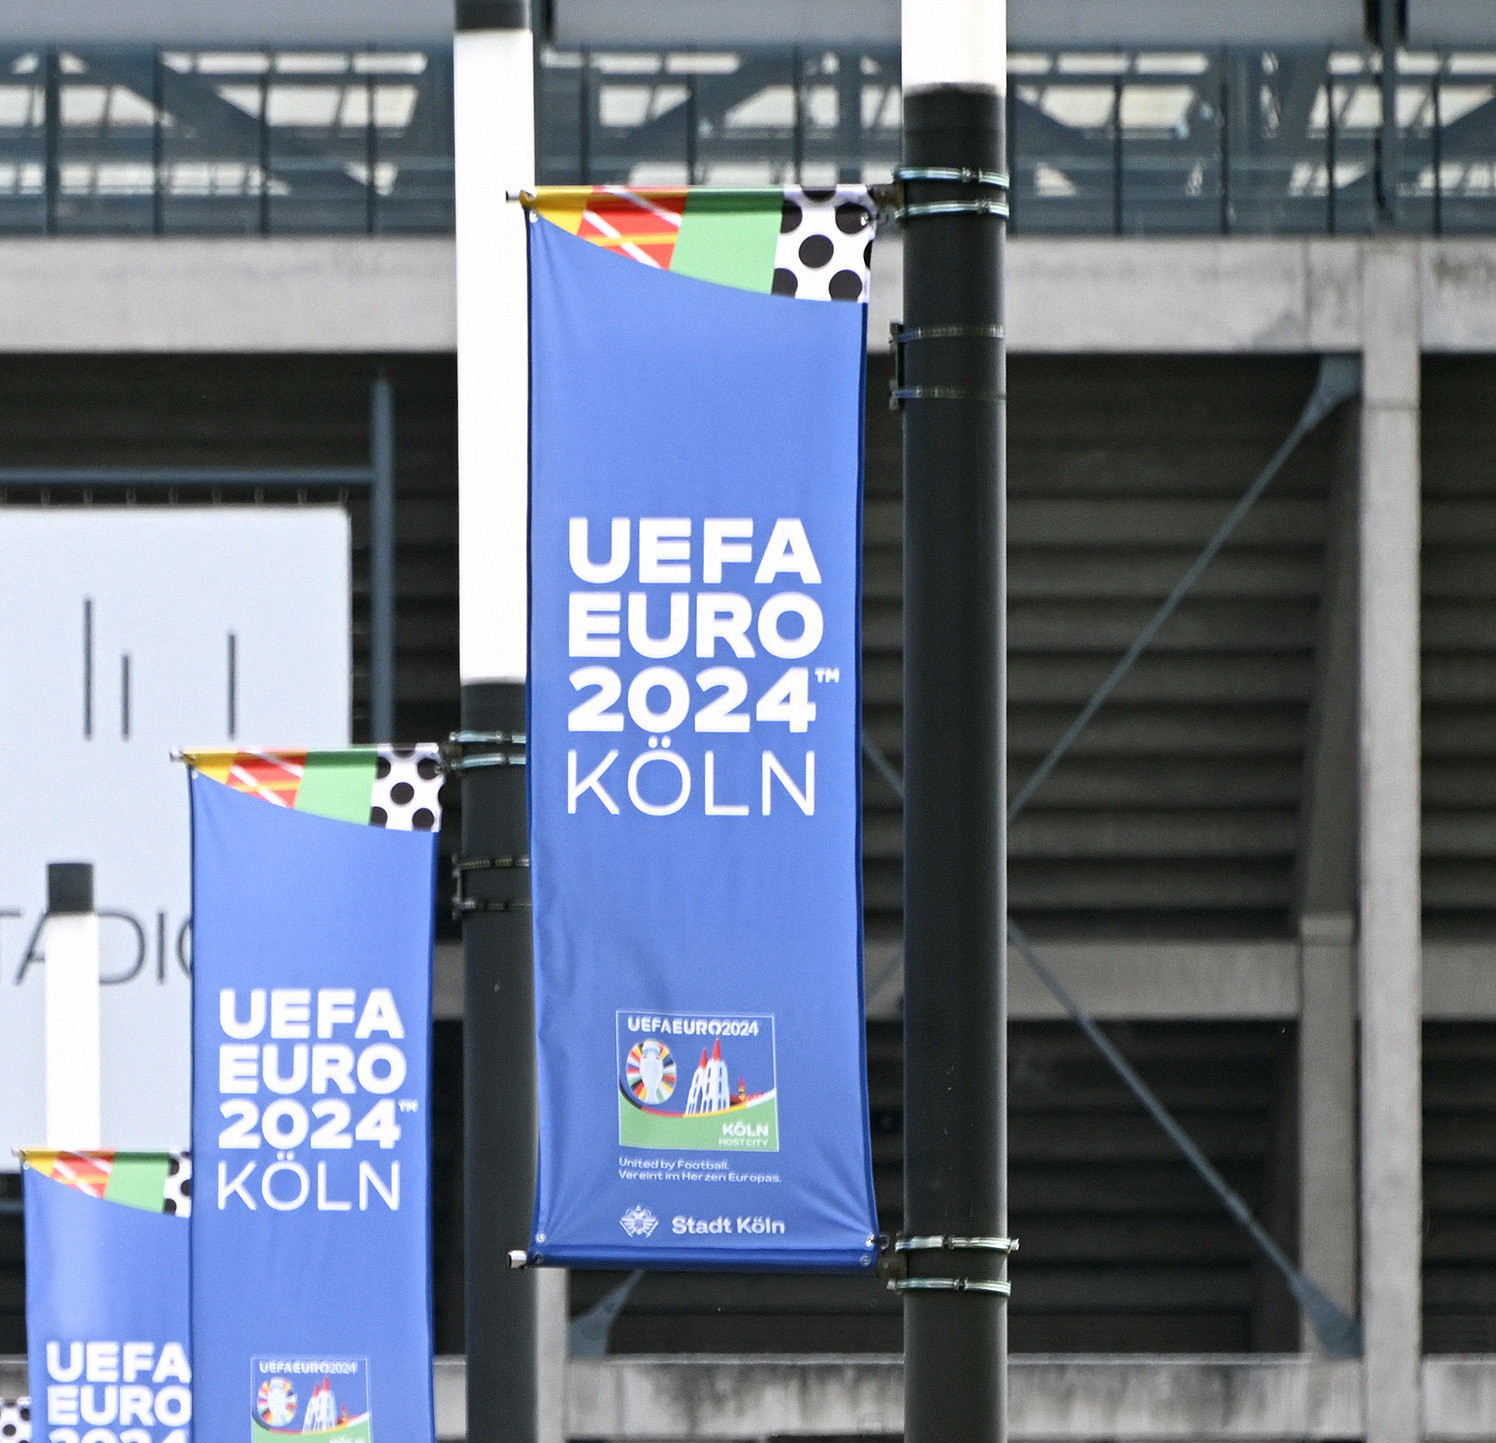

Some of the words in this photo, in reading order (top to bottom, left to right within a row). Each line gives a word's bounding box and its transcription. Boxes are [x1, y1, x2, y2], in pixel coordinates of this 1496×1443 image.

[568, 516, 821, 586] UEFA
[568, 591, 824, 660] EURO
[566, 735, 816, 817] KÖLN
[220, 988, 405, 1040] UEFA
[219, 1044, 406, 1094] EURO
[722, 1121, 769, 1137] KÖLN
[218, 1151, 400, 1211] KÖLN
[619, 1157, 659, 1169] United
[660, 1158, 676, 1171] by
[677, 1160, 729, 1170] Football.
[619, 1169, 664, 1181] Vereint
[665, 1171, 680, 1181] im
[681, 1172, 727, 1182] Herzen
[728, 1173, 782, 1184] Europas.
[672, 1215, 733, 1235] Stadt
[737, 1215, 786, 1235] Köln
[46, 1341, 192, 1383] UEFA
[47, 1385, 192, 1426] EURO
